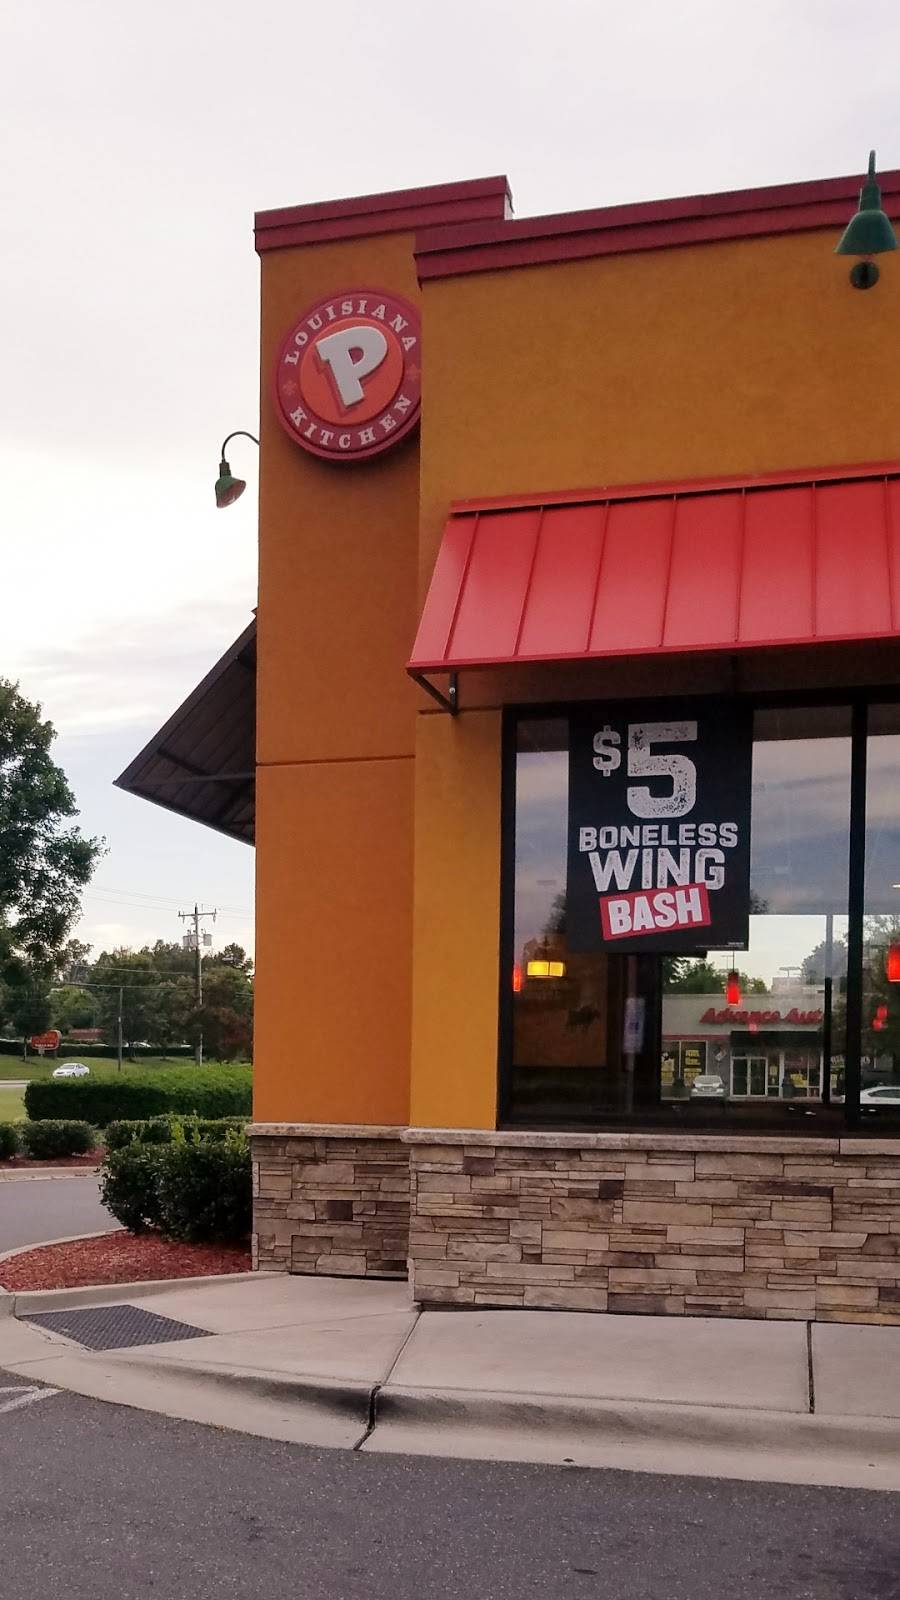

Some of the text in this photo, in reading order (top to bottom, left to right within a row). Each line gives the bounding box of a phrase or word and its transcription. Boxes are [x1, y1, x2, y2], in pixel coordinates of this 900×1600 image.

[285, 300, 416, 365] LOUISIANA
[316, 326, 387, 406] P
[290, 395, 412, 448] KITCHEN
[593, 721, 698, 818] $5
[579, 822, 738, 851] BONELESS
[588, 848, 726, 892] WING
[608, 888, 703, 934] BASH
[783, 1008, 823, 1025] Aut
